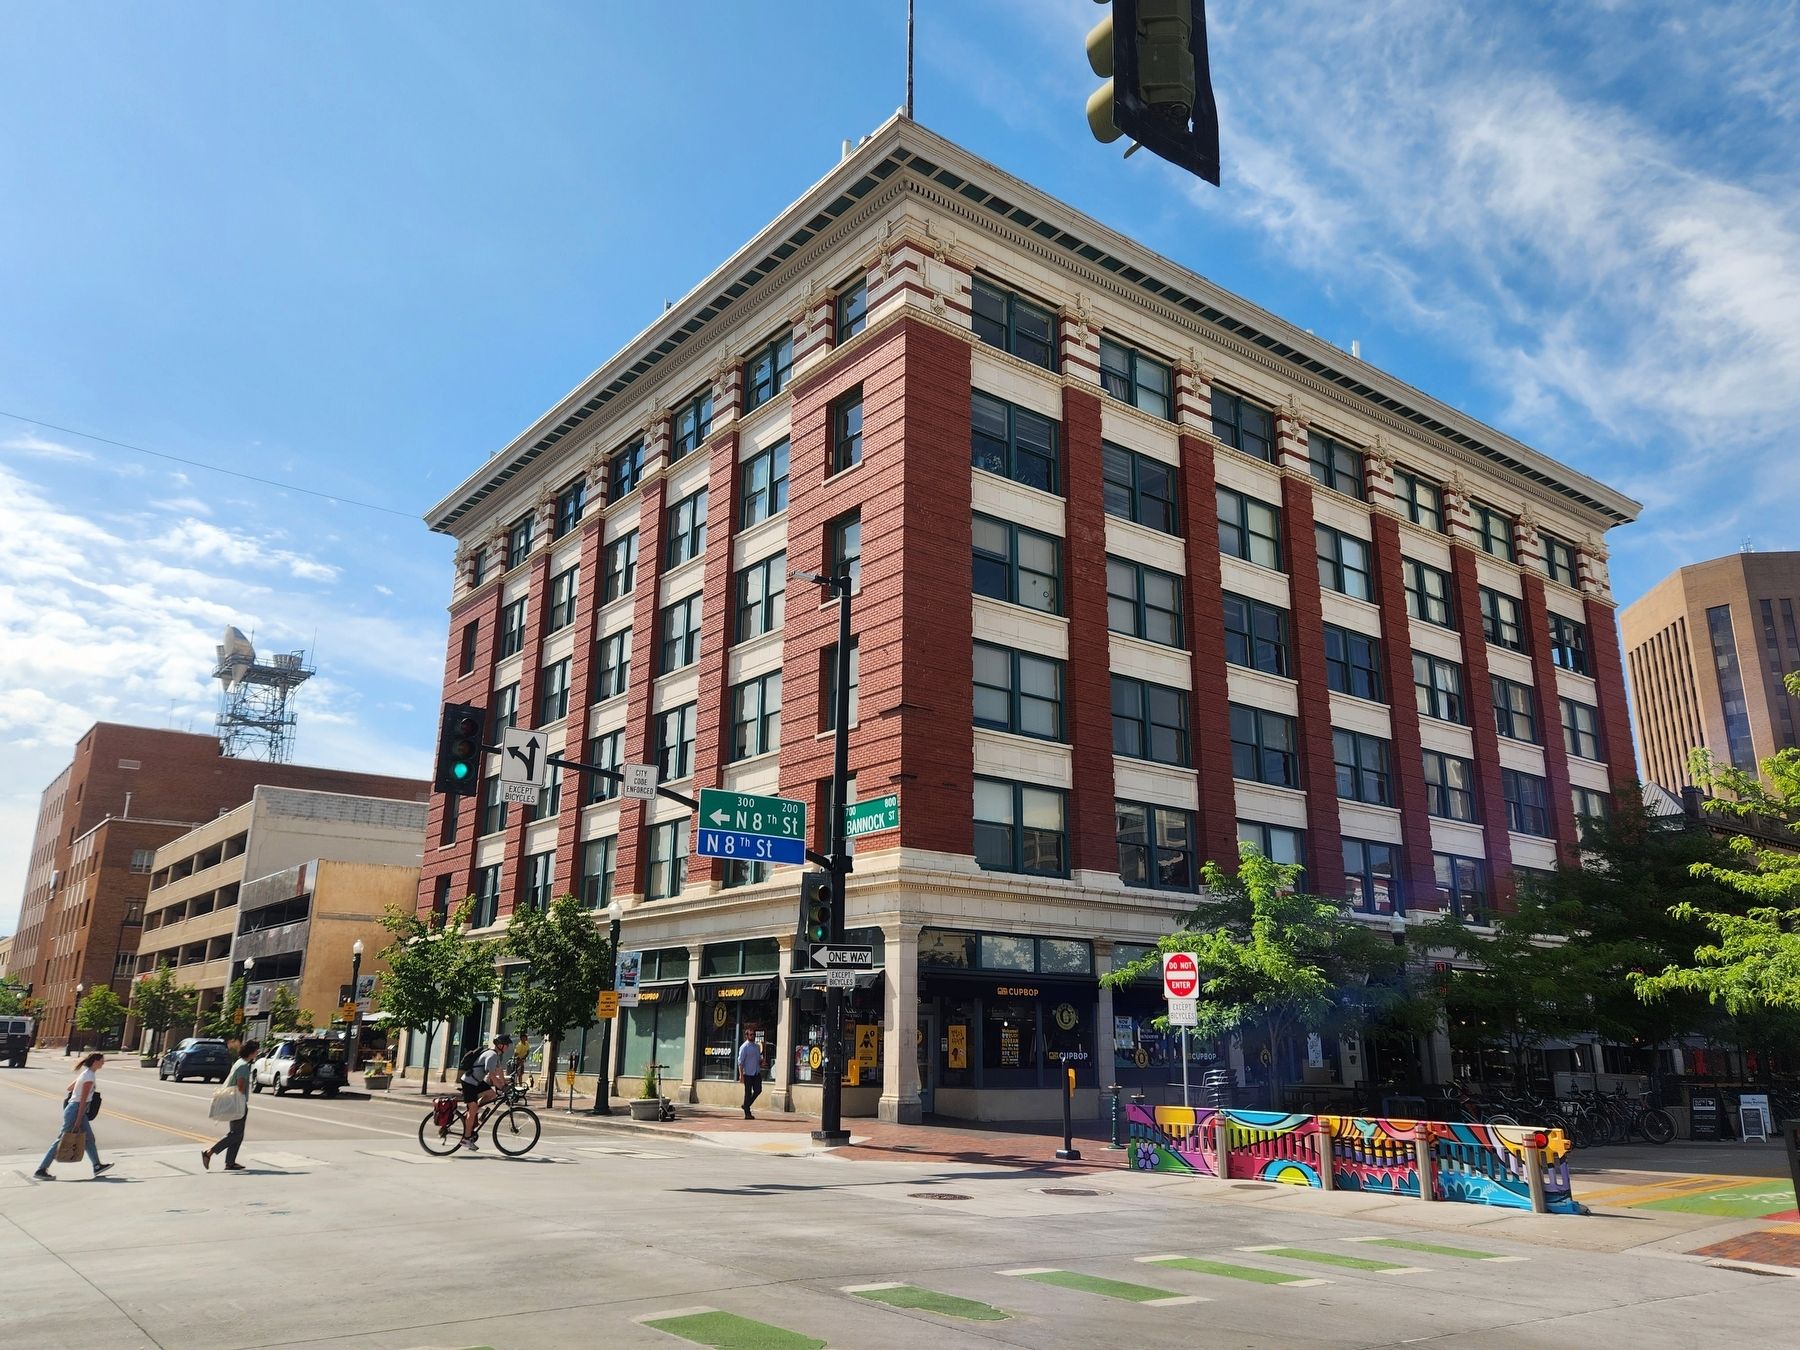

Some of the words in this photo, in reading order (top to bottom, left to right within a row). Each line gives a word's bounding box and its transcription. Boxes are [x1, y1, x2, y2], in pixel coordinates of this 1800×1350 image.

[635, 769, 648, 777] CITY
[633, 777, 648, 786] CODE
[508, 785, 533, 796] EXCEPT
[626, 786, 653, 795] ENFORCED
[504, 793, 536, 804] BICYCLES
[884, 798, 897, 808] 800
[737, 796, 755, 808] 300
[782, 803, 798, 814] 200
[736, 811, 747, 829] N
[782, 816, 798, 836] St
[846, 812, 885, 834] BANNOCK
[888, 810, 896, 821] ST
[707, 833, 719, 853] N
[756, 839, 773, 858] St
[828, 951, 847, 963] ONE
[849, 952, 869, 963] WAY
[1168, 962, 1178, 970] DO
[1180, 961, 1192, 970] NOT
[831, 971, 851, 979] EXCEPT
[829, 978, 853, 986] BICYCLES
[1171, 981, 1191, 989] ENTER
[725, 988, 745, 997] CUPBOP
[1008, 987, 1039, 997] CUPBOP
[1172, 1003, 1192, 1011] EXCEPT
[1170, 1012, 1195, 1020] BICYCLES
[711, 1047, 732, 1056] CUPBOP
[1059, 1051, 1088, 1061] CUPBOP
